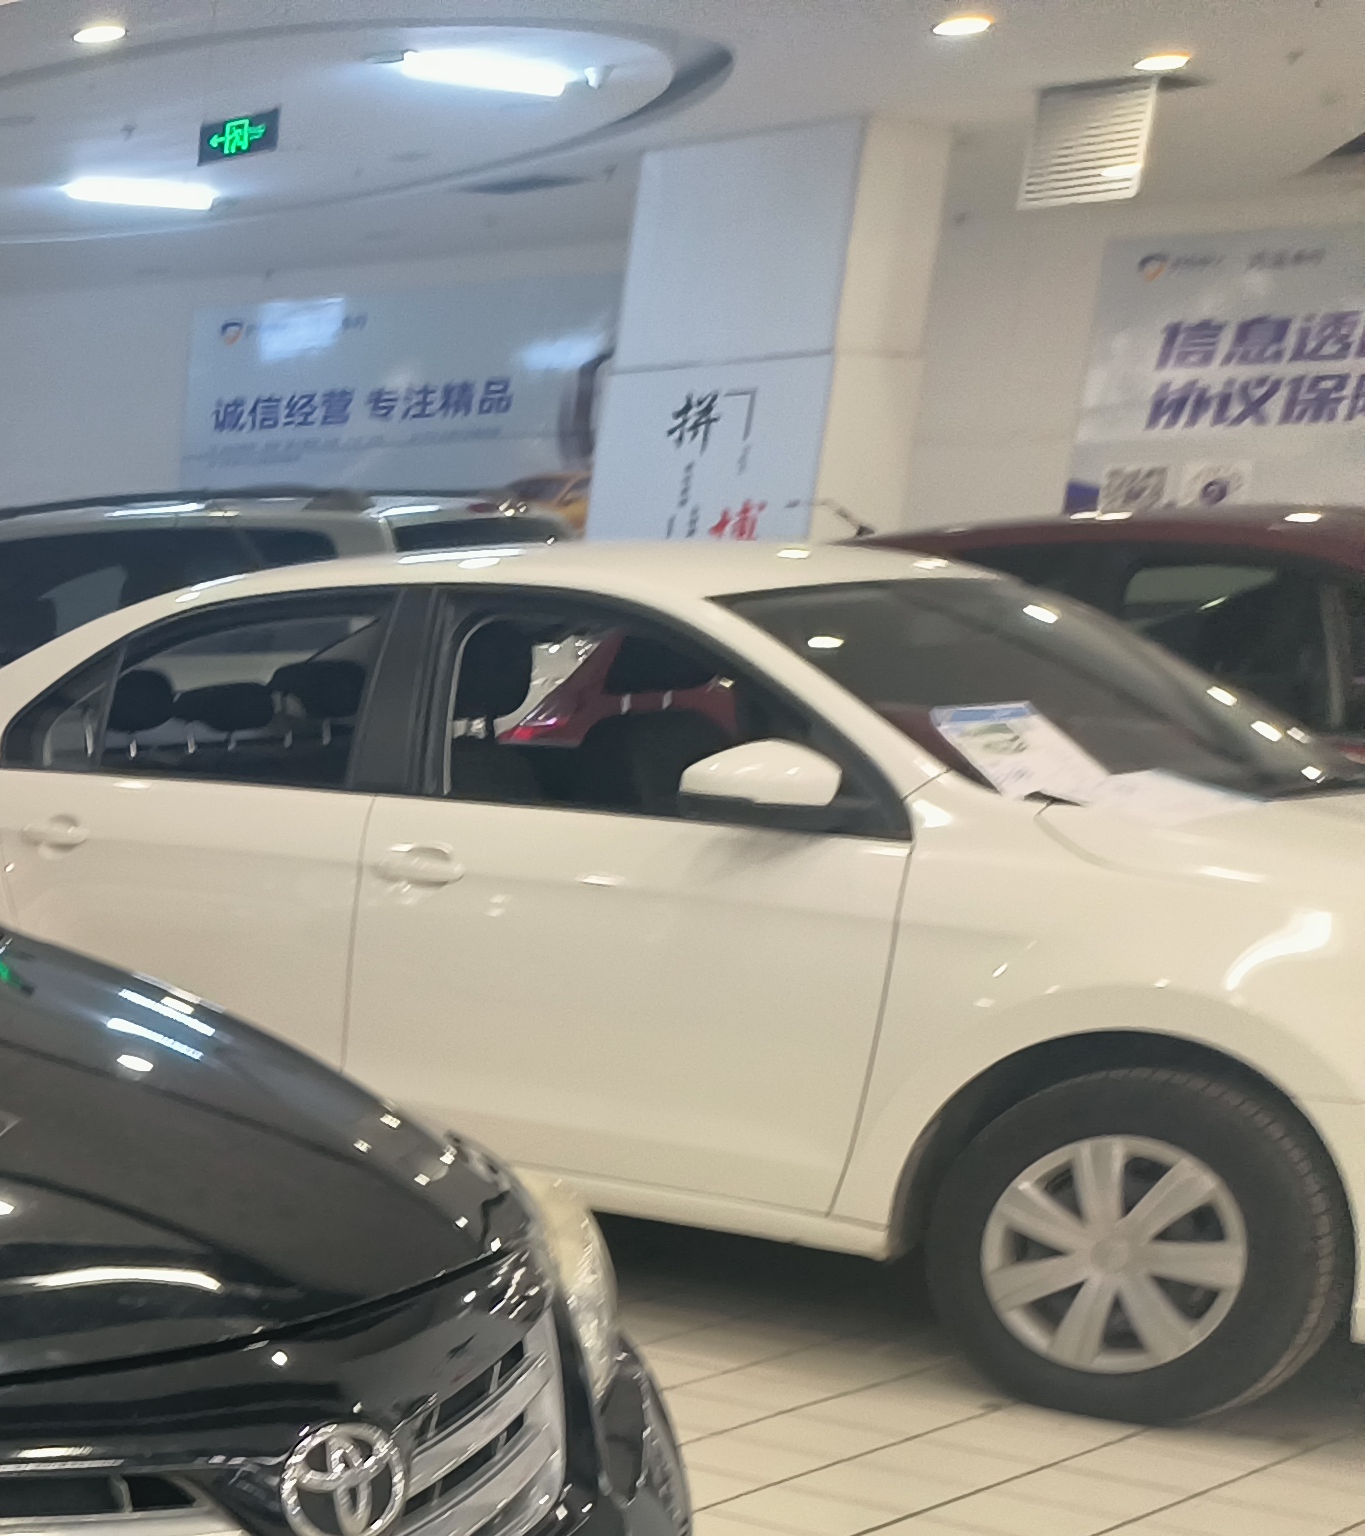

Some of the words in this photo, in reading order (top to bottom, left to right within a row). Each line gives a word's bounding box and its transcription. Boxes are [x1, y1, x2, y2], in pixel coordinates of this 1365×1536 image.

[1154, 311, 1365, 370] 信息透
[212, 386, 356, 433] 诚信经营
[365, 375, 515, 422] 专注精品
[667, 390, 721, 455] 拼
